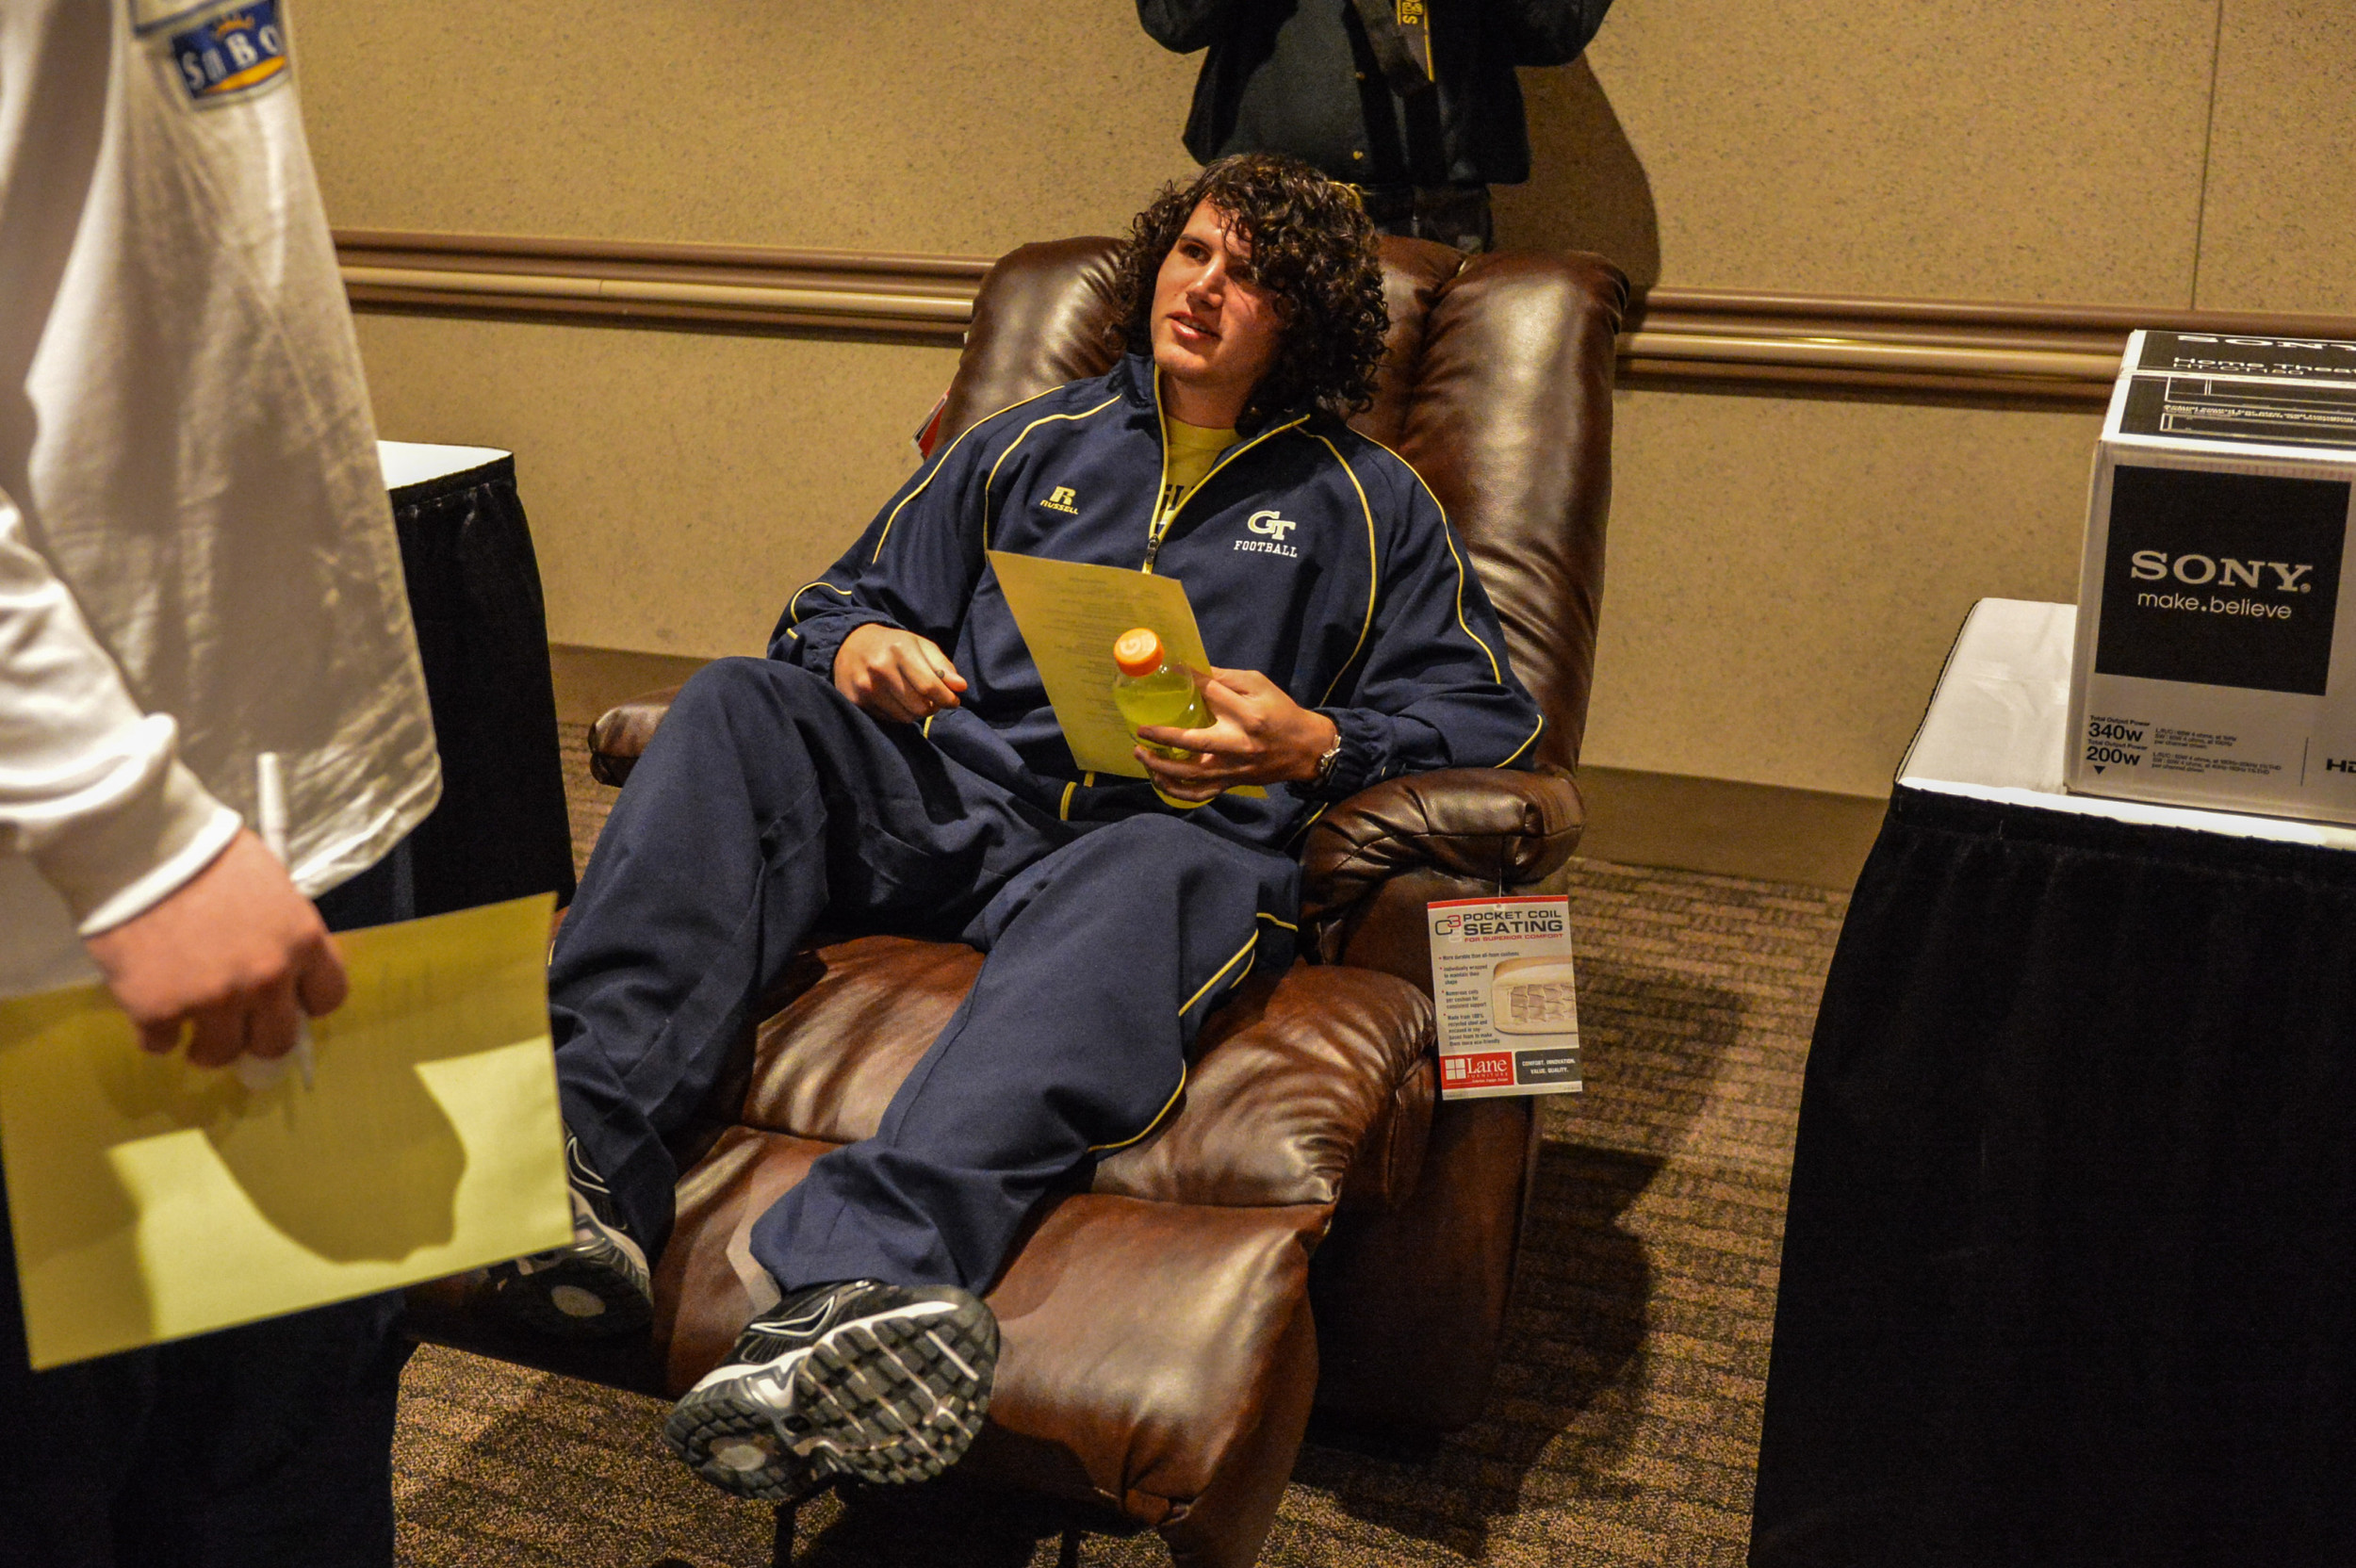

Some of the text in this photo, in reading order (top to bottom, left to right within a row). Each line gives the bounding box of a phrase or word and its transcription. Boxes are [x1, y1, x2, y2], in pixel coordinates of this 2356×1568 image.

[2174, 357, 2356, 374] Home Thea
[1049, 485, 1076, 506] R
[1039, 499, 1079, 515] RUSSELL
[1248, 510, 1297, 541] GT
[1234, 540, 1298, 558] FOOTBALL
[2131, 550, 2313, 594] SONY
[1463, 910, 1562, 922] POCKET COIL
[1464, 920, 1563, 936] SEATING
[1466, 1057, 1508, 1074] Lane
